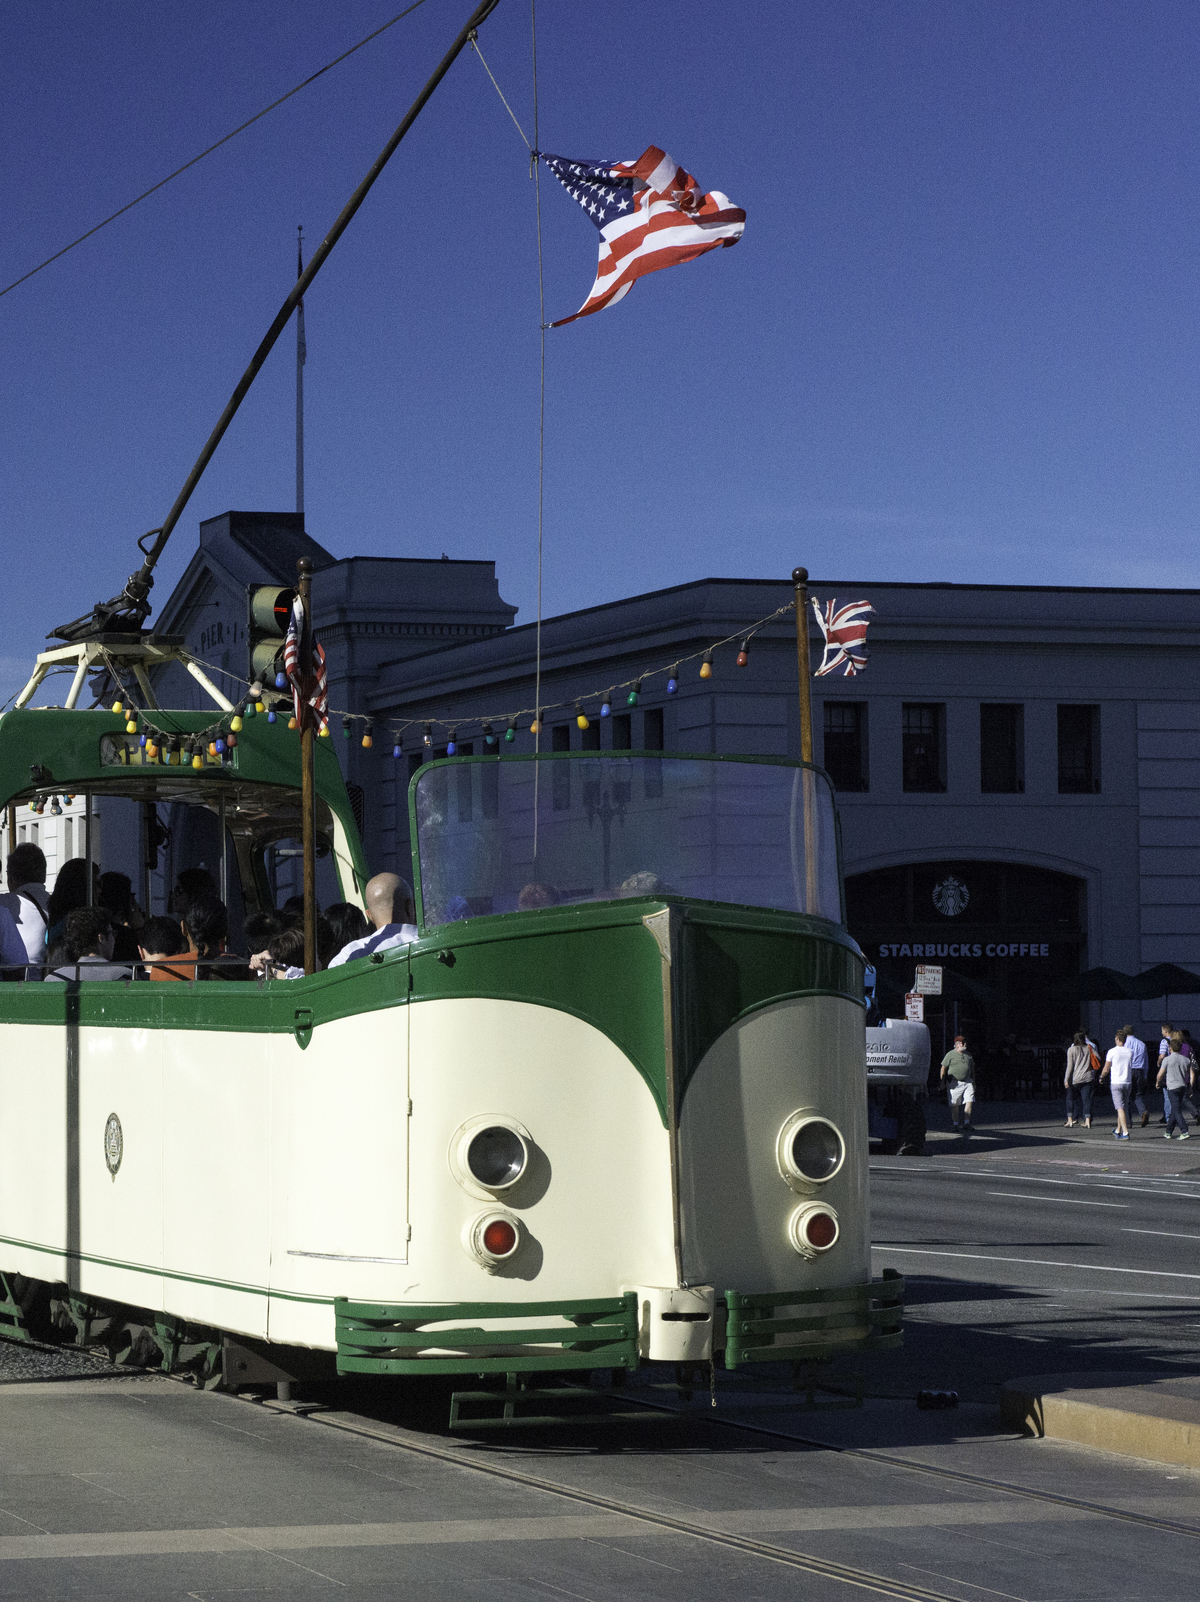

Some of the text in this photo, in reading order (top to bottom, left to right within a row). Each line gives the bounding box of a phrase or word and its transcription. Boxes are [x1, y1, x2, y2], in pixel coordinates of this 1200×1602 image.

[200, 621, 225, 654] PIER
[879, 943, 1049, 957] STARBUCKS COFFEE
[888, 1054, 910, 1064] Rental
